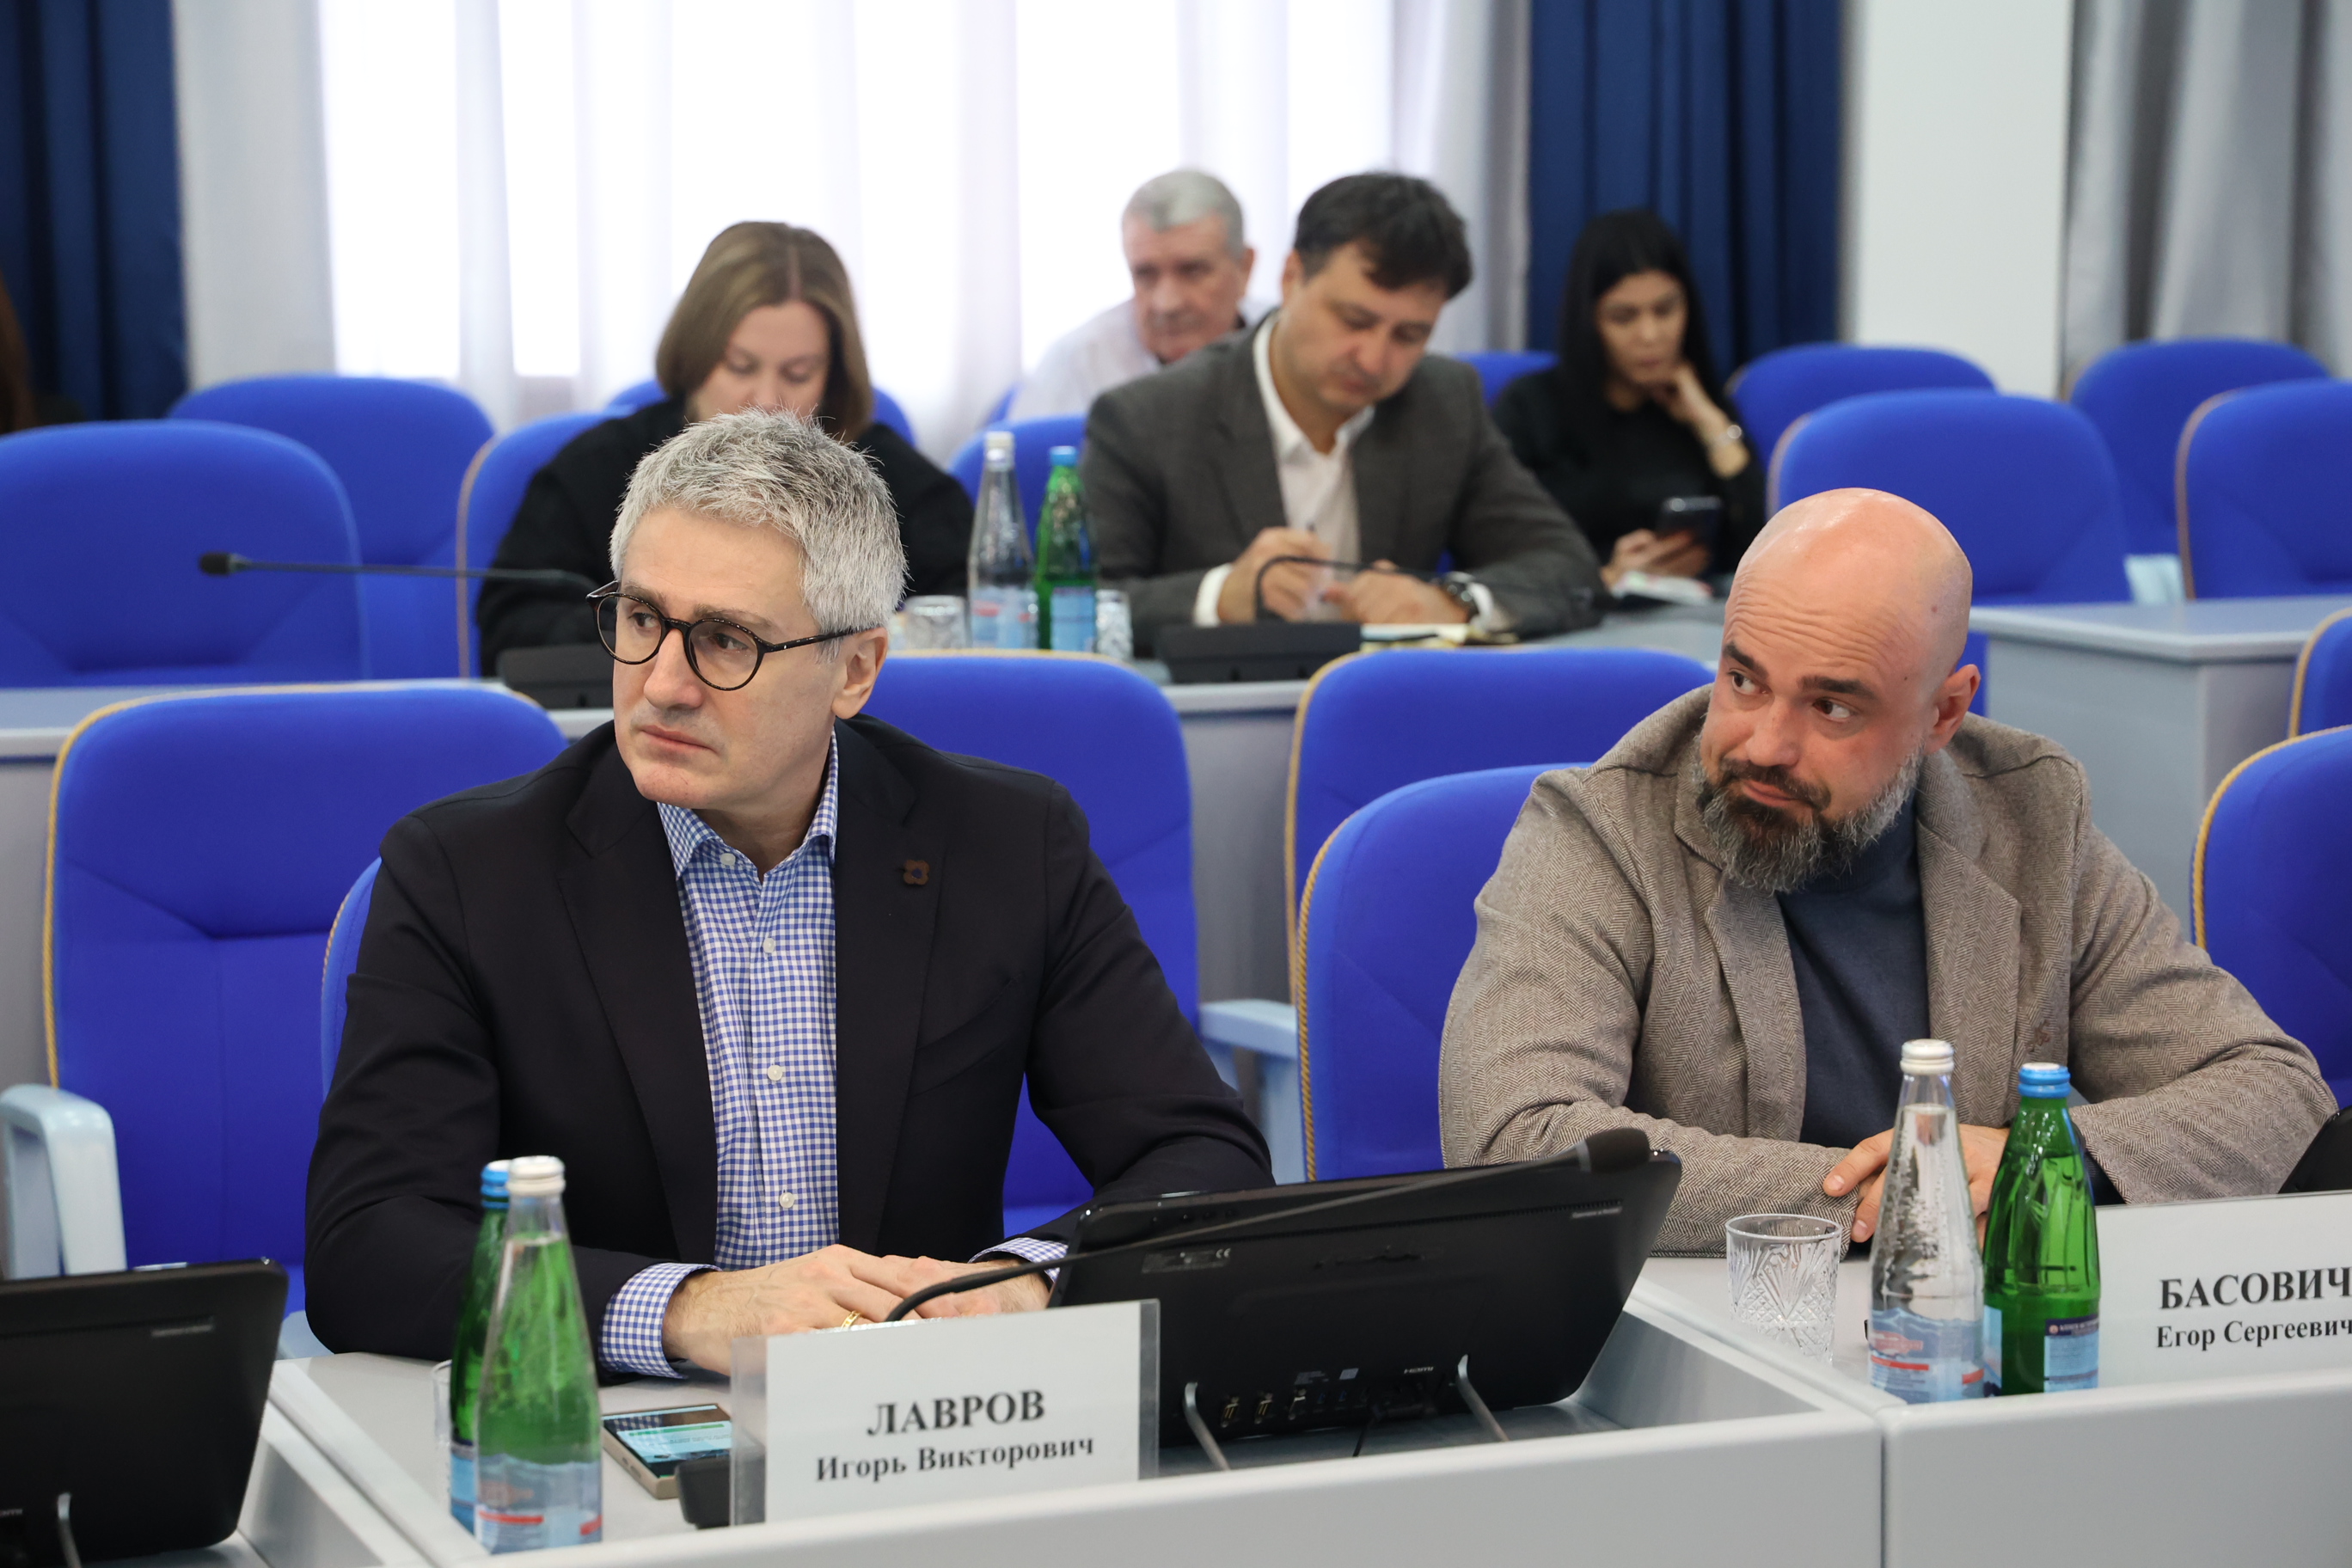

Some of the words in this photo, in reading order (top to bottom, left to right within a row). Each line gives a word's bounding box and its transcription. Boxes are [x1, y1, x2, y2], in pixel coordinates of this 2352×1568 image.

[2159, 1266, 2352, 1310] БАСОВИЧ
[2156, 1325, 2215, 1351] Егор
[2223, 1319, 2352, 1348] Сергеевич
[866, 1388, 1046, 1436] ЛАВРОВ
[815, 1455, 907, 1482] Игорь
[917, 1437, 1093, 1471] Викторович
